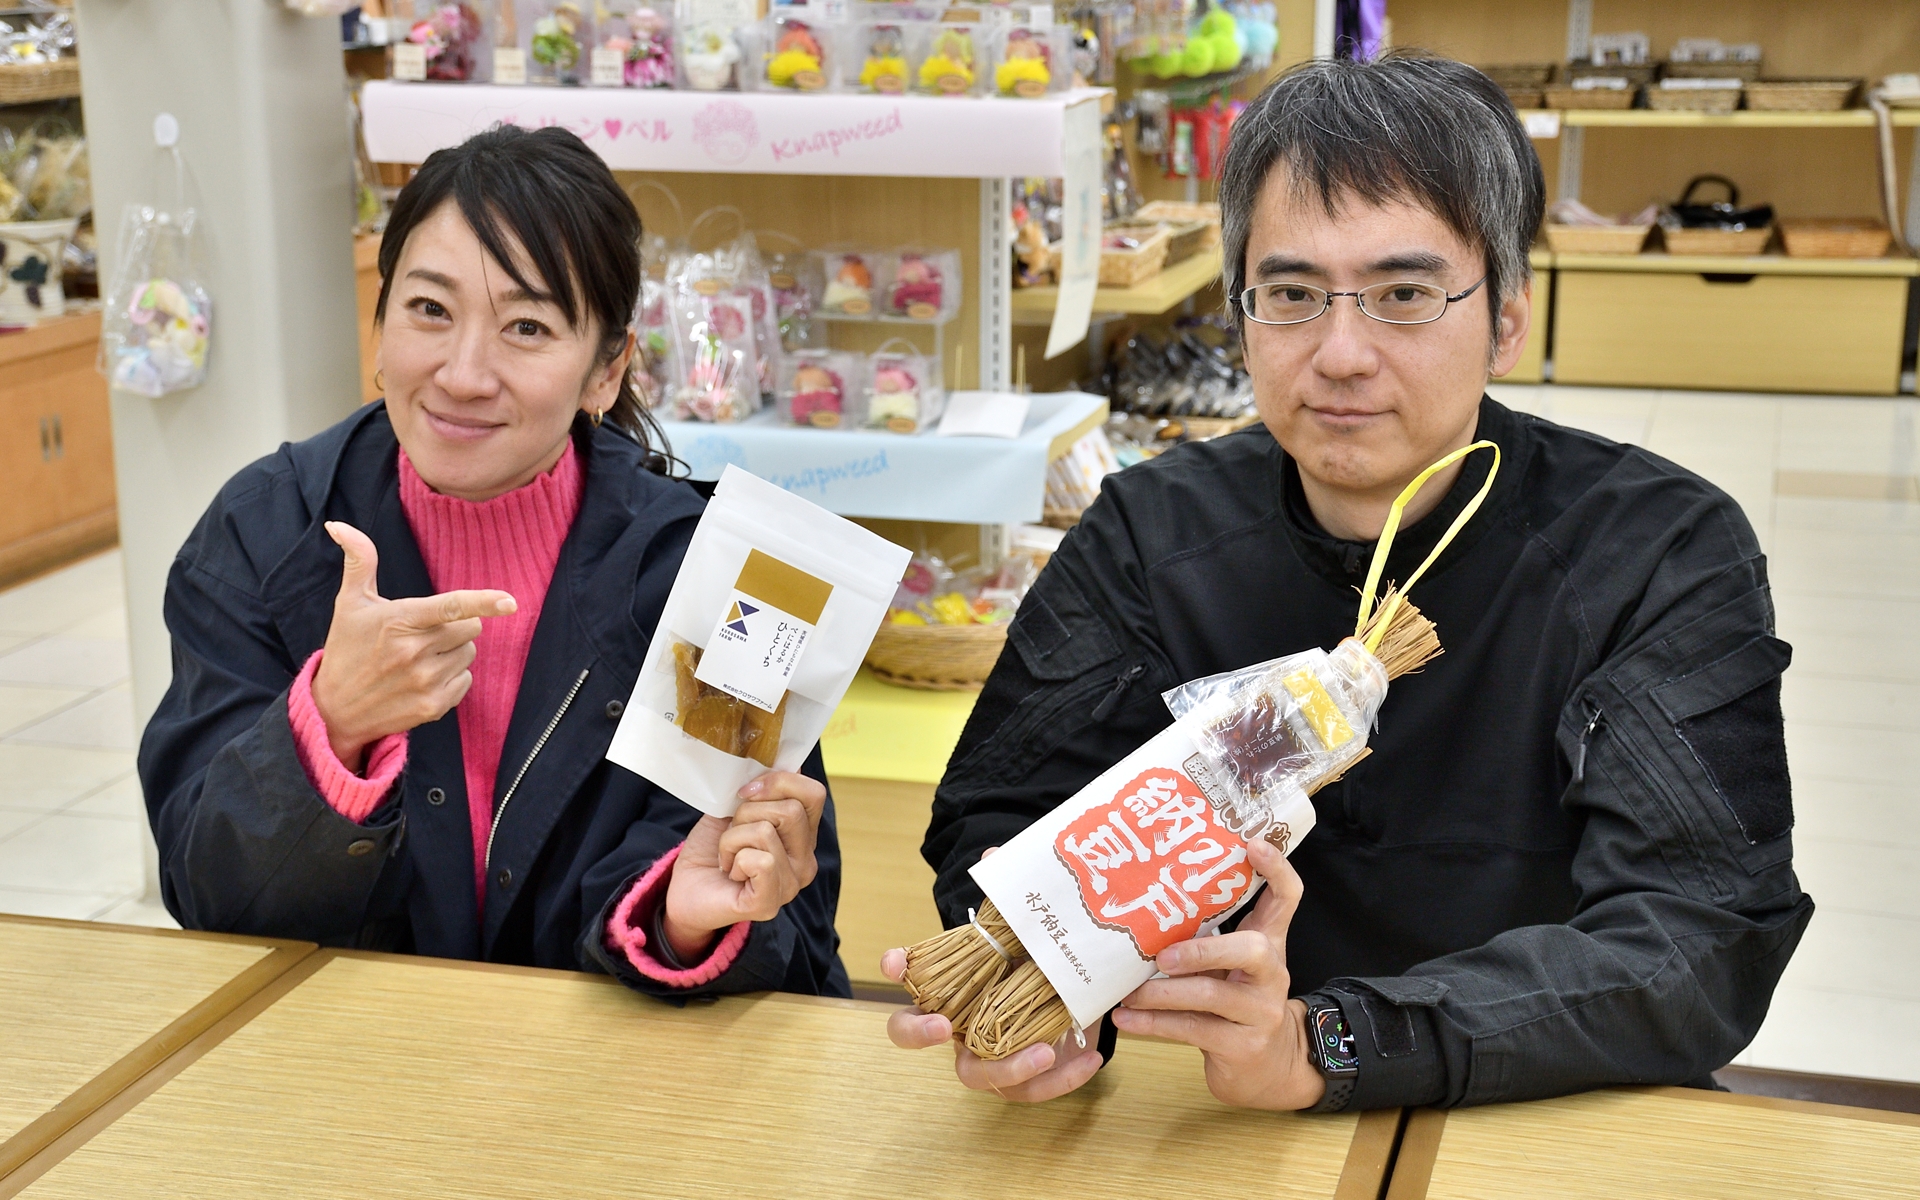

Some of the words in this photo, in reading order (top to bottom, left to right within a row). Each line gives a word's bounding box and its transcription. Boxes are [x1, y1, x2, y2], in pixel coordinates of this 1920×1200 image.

[768, 448, 890, 495] napweed
[721, 627, 747, 643] KUROSAWA
[762, 621, 788, 668] ひとくち
